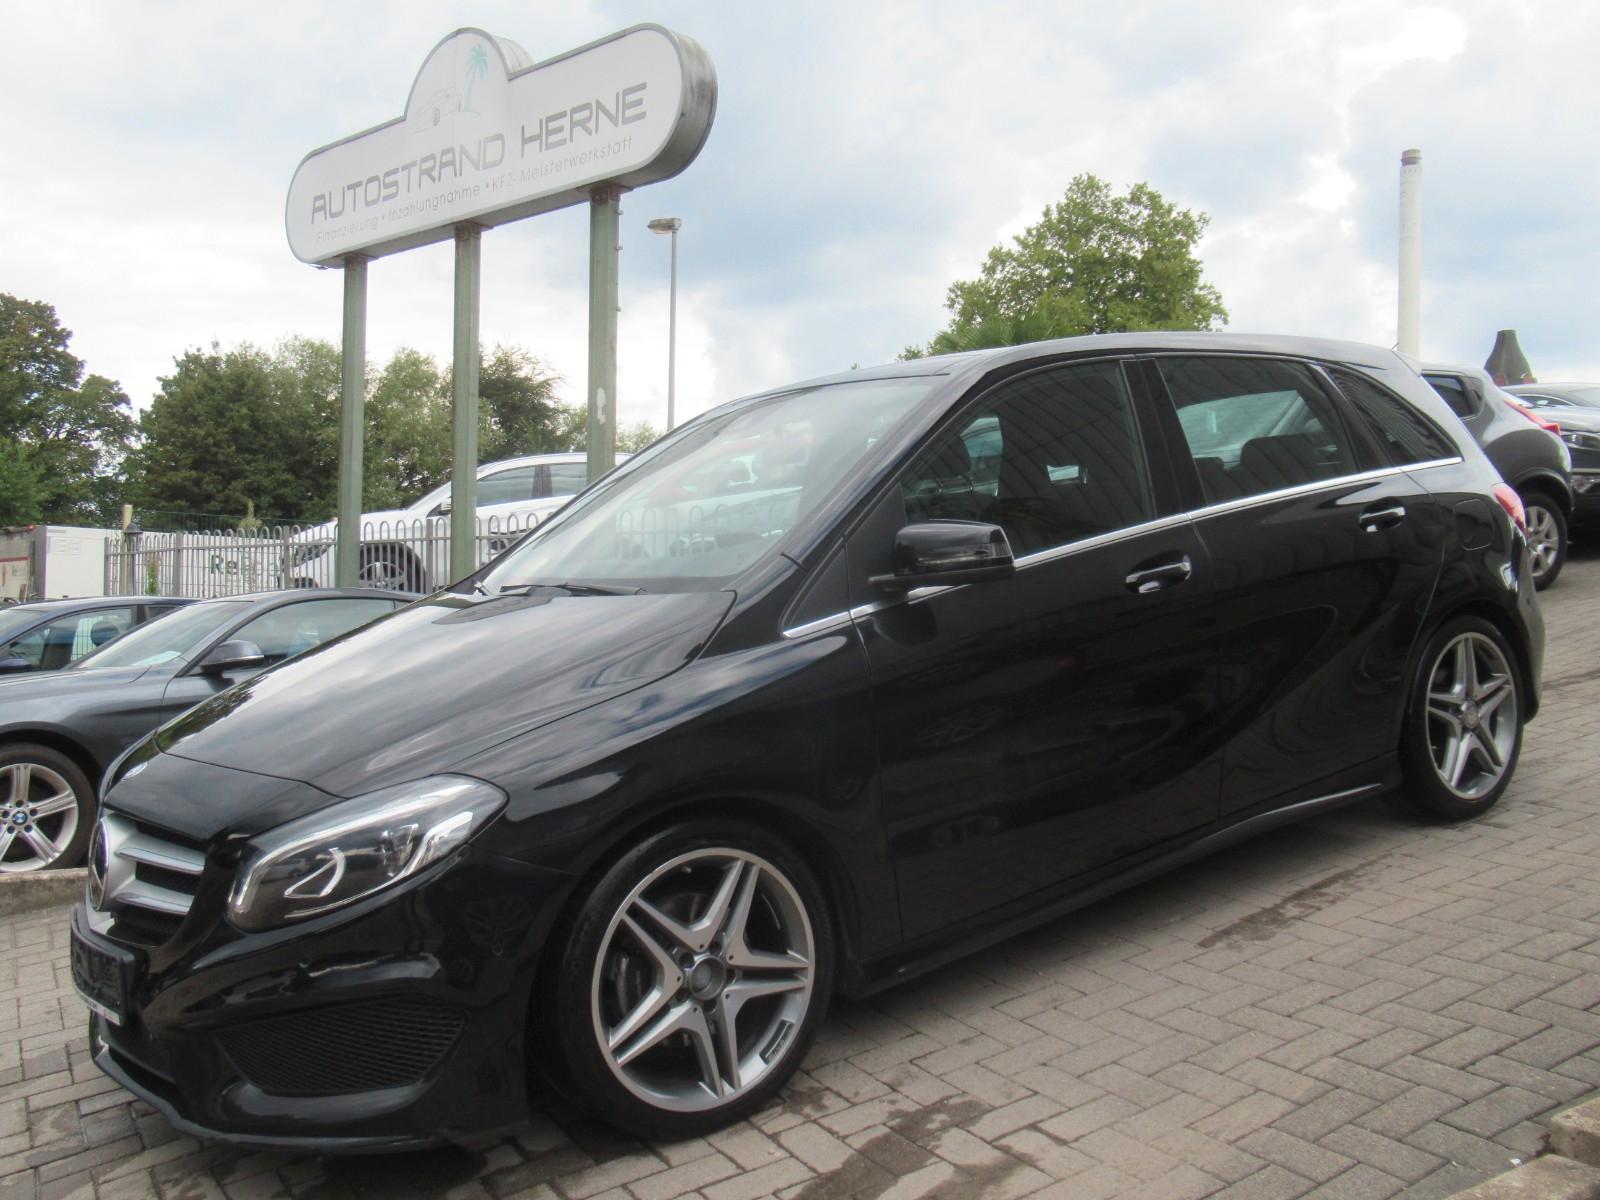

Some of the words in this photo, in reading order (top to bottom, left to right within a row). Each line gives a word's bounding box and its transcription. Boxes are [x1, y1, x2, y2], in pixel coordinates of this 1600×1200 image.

[311, 133, 506, 225] AUTOSTRAND
[520, 82, 648, 158] HERNE
[388, 183, 481, 222] Inzahlungnahme
